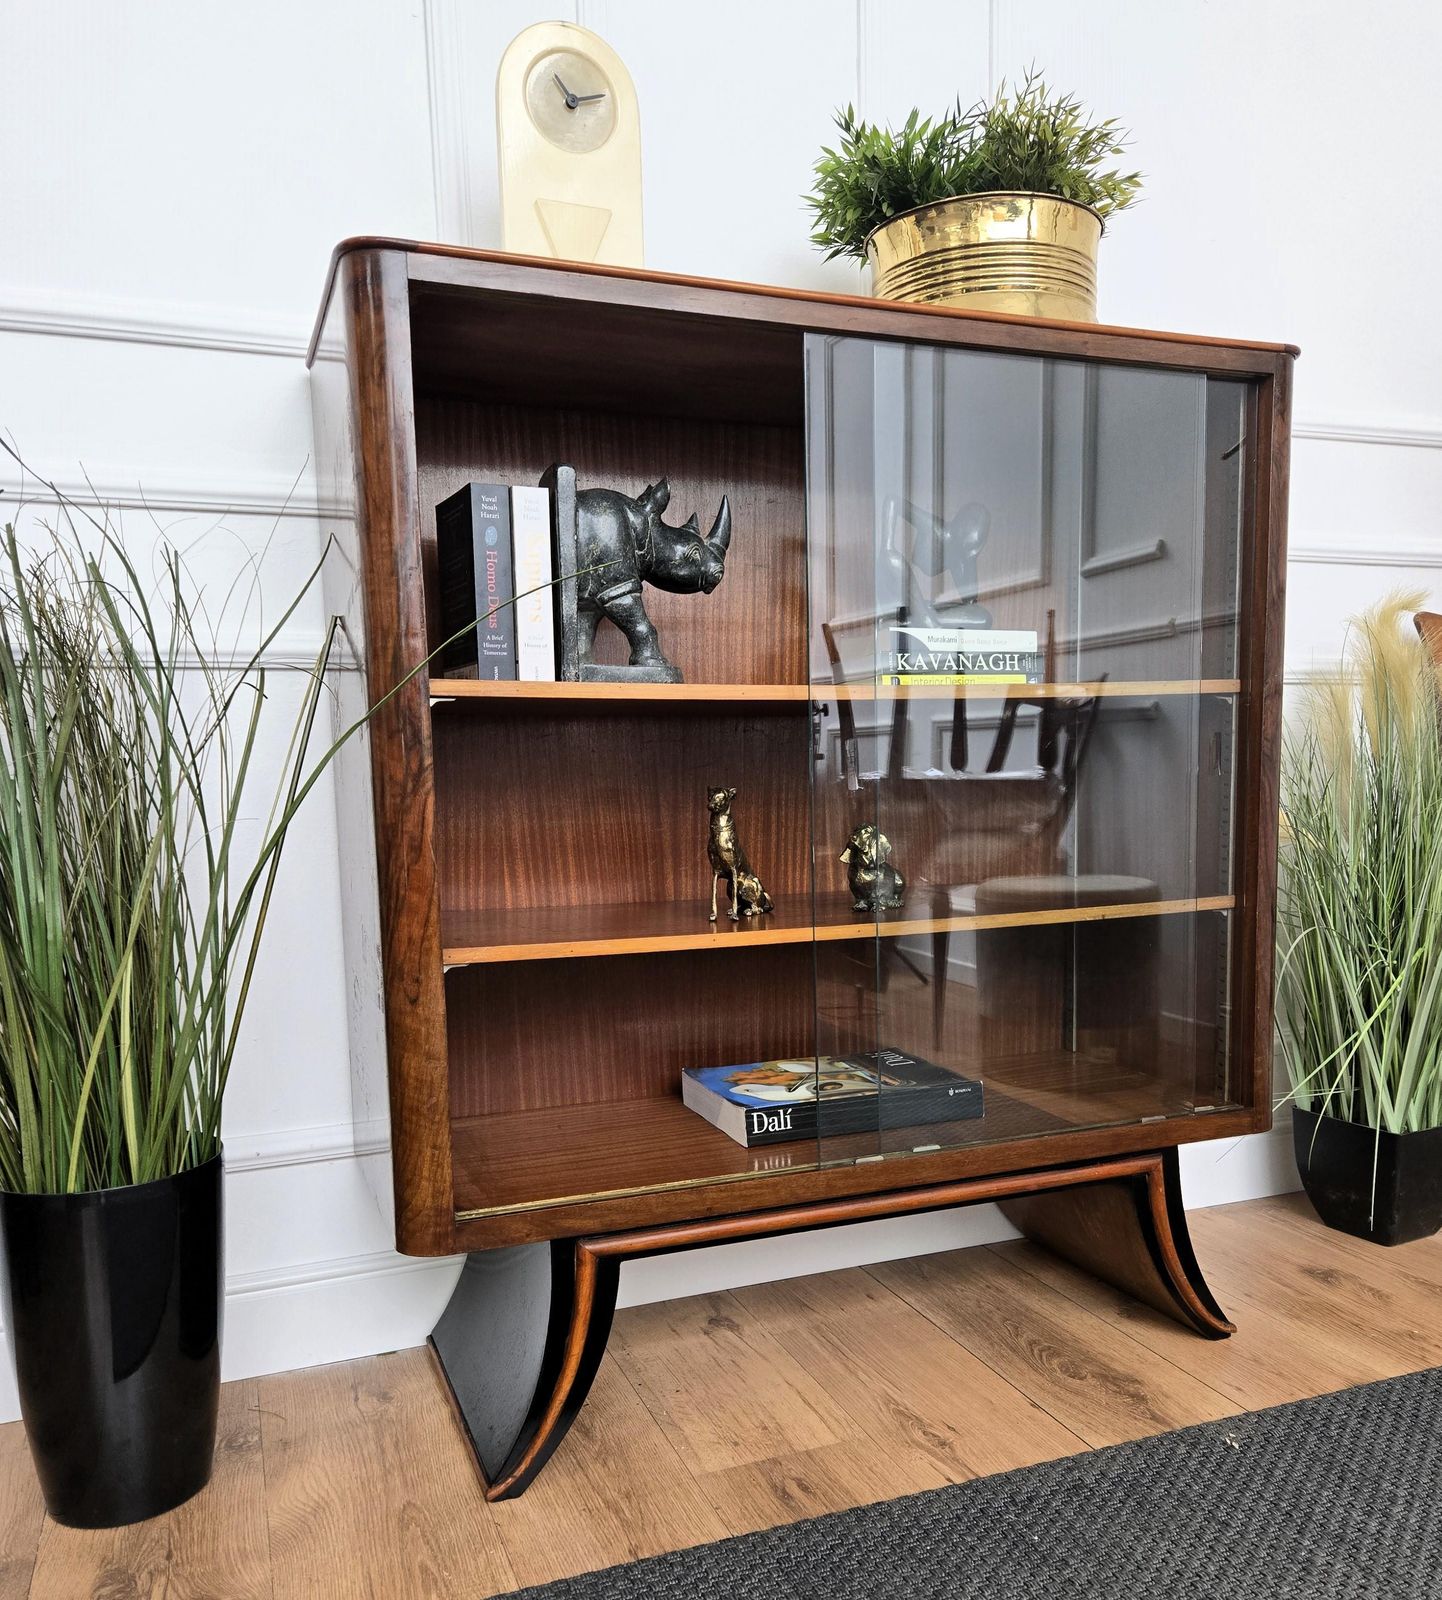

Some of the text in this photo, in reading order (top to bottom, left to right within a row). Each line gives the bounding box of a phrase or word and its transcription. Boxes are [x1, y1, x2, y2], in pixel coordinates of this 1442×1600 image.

[481, 495, 498, 503] Yuval
[481, 503, 498, 511] Noah
[480, 511, 500, 519] Harari
[486, 550, 498, 592] Homo
[927, 635, 958, 644] Murakami
[483, 641, 500, 650] History
[895, 653, 1020, 671] KAVANAGH
[911, 676, 943, 686] Interior
[945, 676, 976, 686] Design
[750, 1107, 793, 1134] Dalí
